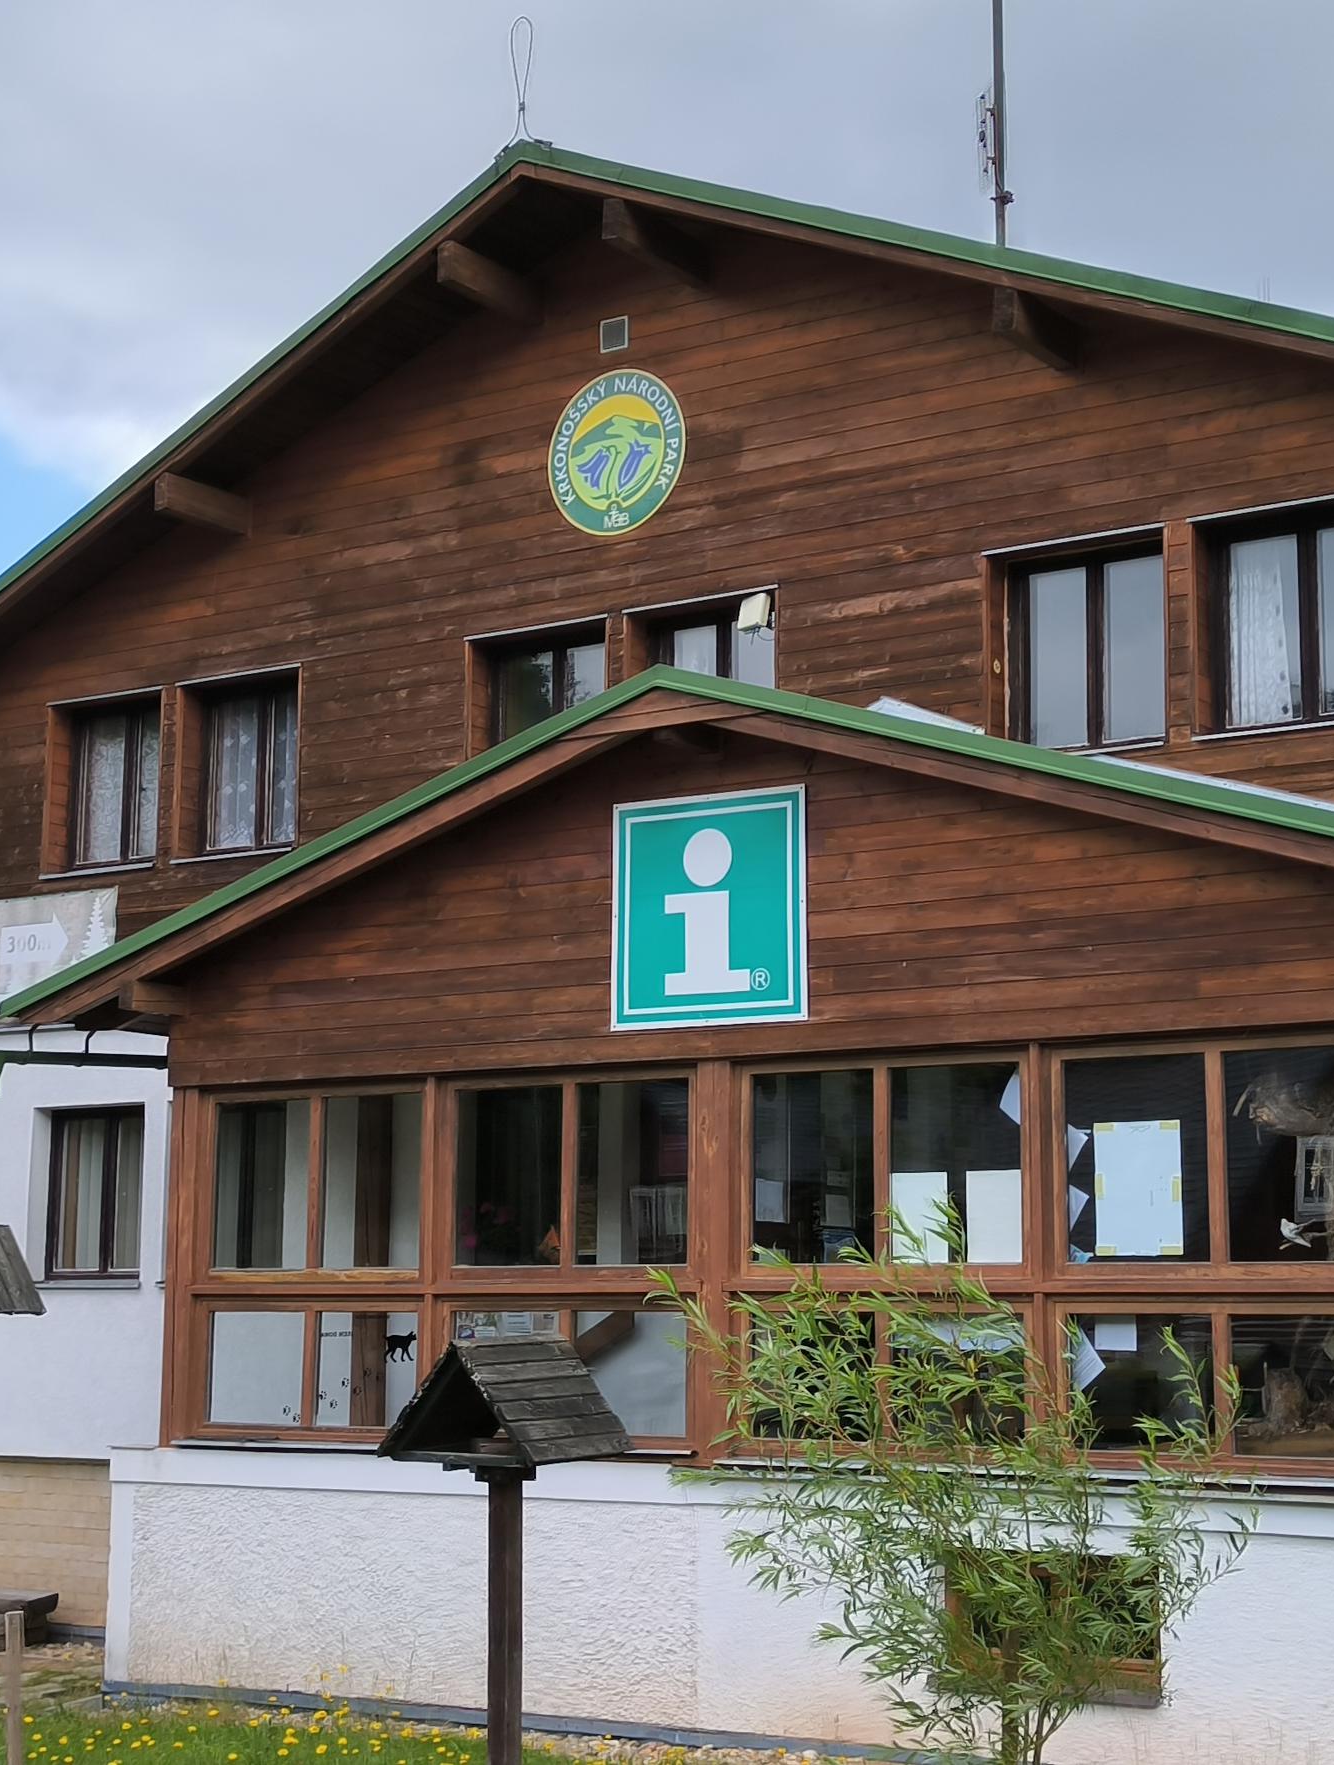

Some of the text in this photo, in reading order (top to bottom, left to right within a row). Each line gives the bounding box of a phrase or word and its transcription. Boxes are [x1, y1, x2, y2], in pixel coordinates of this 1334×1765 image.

[554, 374, 680, 505] KRKONOŠSKÝ NÁRODNÍ PARK
